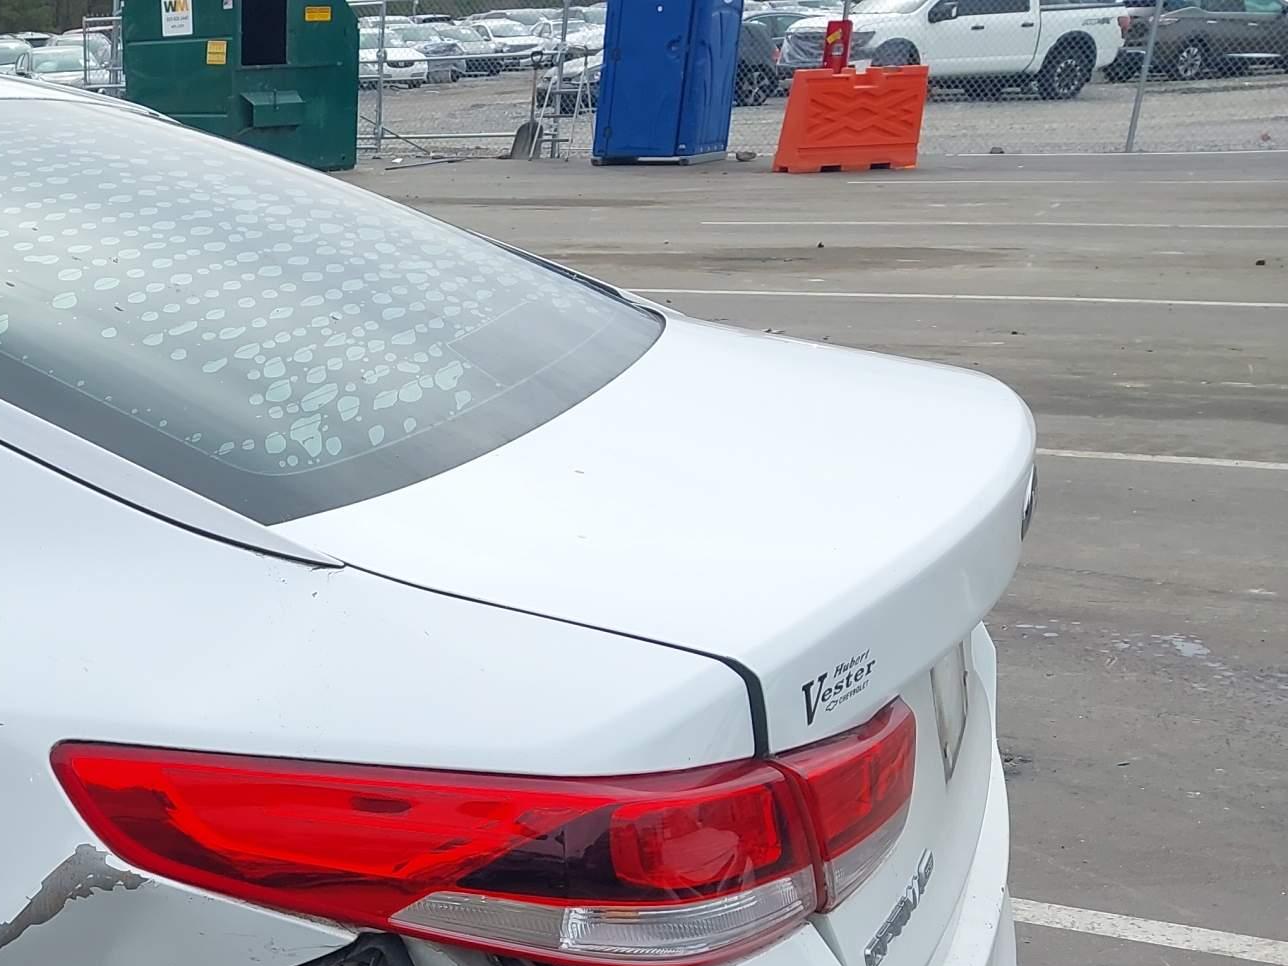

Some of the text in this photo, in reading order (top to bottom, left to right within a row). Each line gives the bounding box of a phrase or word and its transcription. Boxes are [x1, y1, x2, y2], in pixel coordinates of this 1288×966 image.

[164, 0, 189, 13] WM
[833, 649, 870, 679] Hubert
[802, 660, 876, 726] Vester
